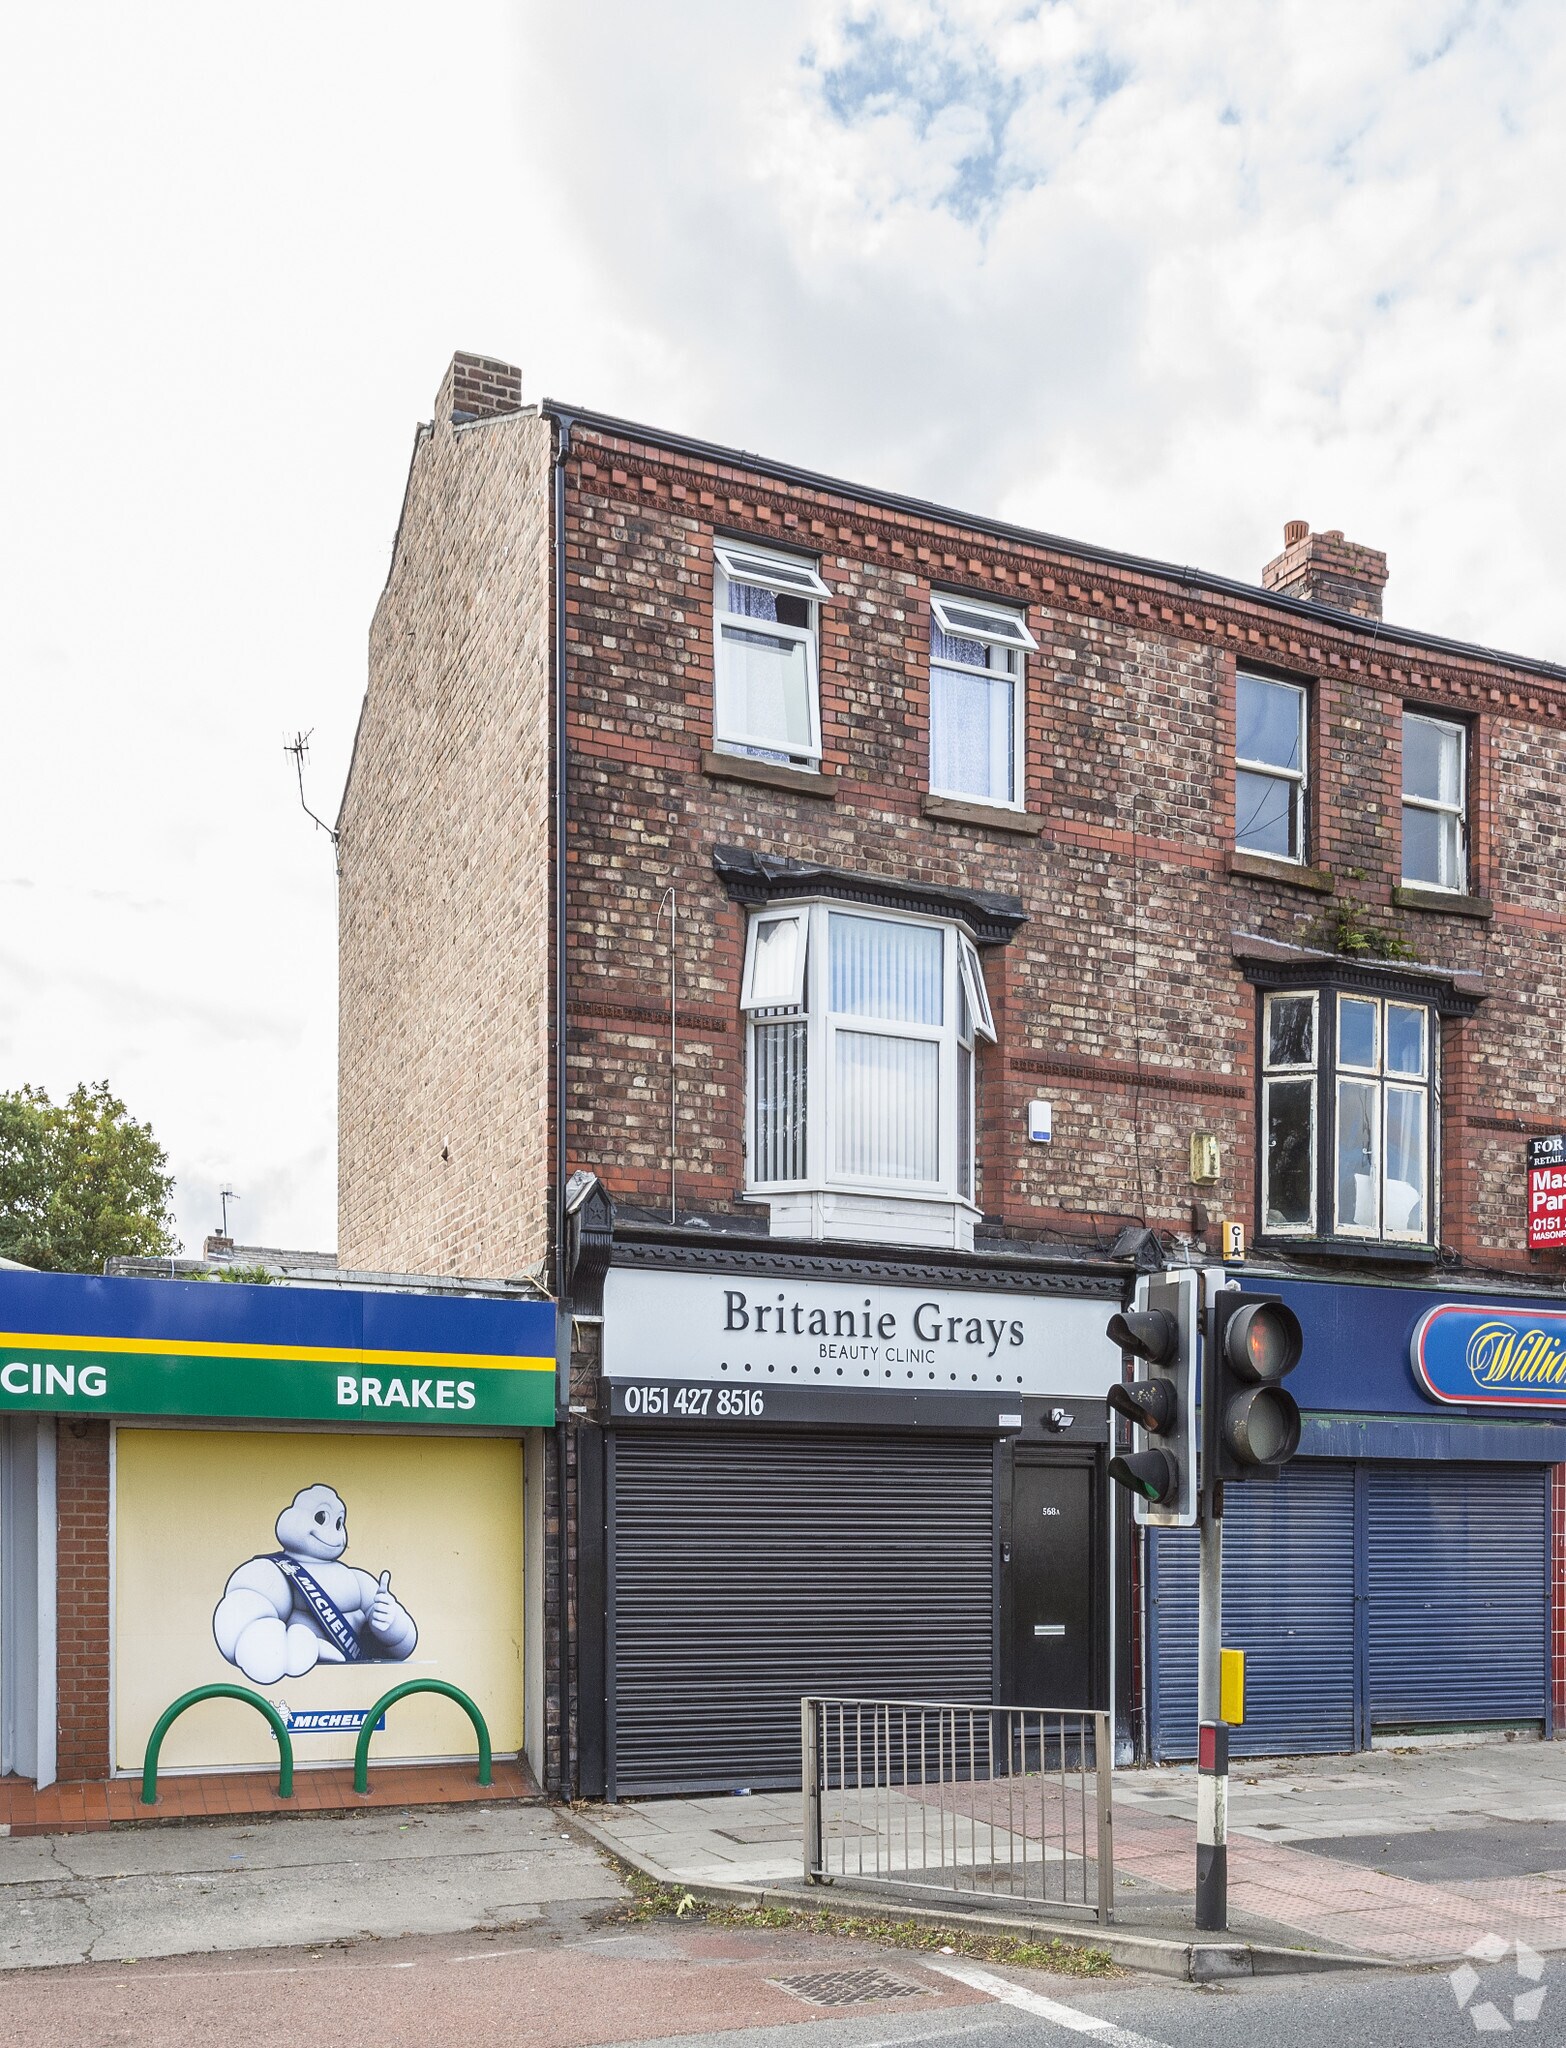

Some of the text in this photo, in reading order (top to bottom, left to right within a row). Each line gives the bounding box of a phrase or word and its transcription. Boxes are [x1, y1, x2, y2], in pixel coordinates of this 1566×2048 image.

[1534, 1139, 1563, 1153] FOR
[1534, 1155, 1563, 1166] RETAIL
[1533, 1216, 1561, 1231] 0151
[1231, 1225, 1242, 1257] CIA
[723, 1290, 1025, 1358] Britanie Grays
[819, 1343, 936, 1364] BEAUTY CLINIC
[0, 1362, 107, 1397] CING
[337, 1376, 476, 1410] BRAKES
[624, 1386, 764, 1416] 0151 427 8516
[298, 1576, 361, 1660] MICHELIN
